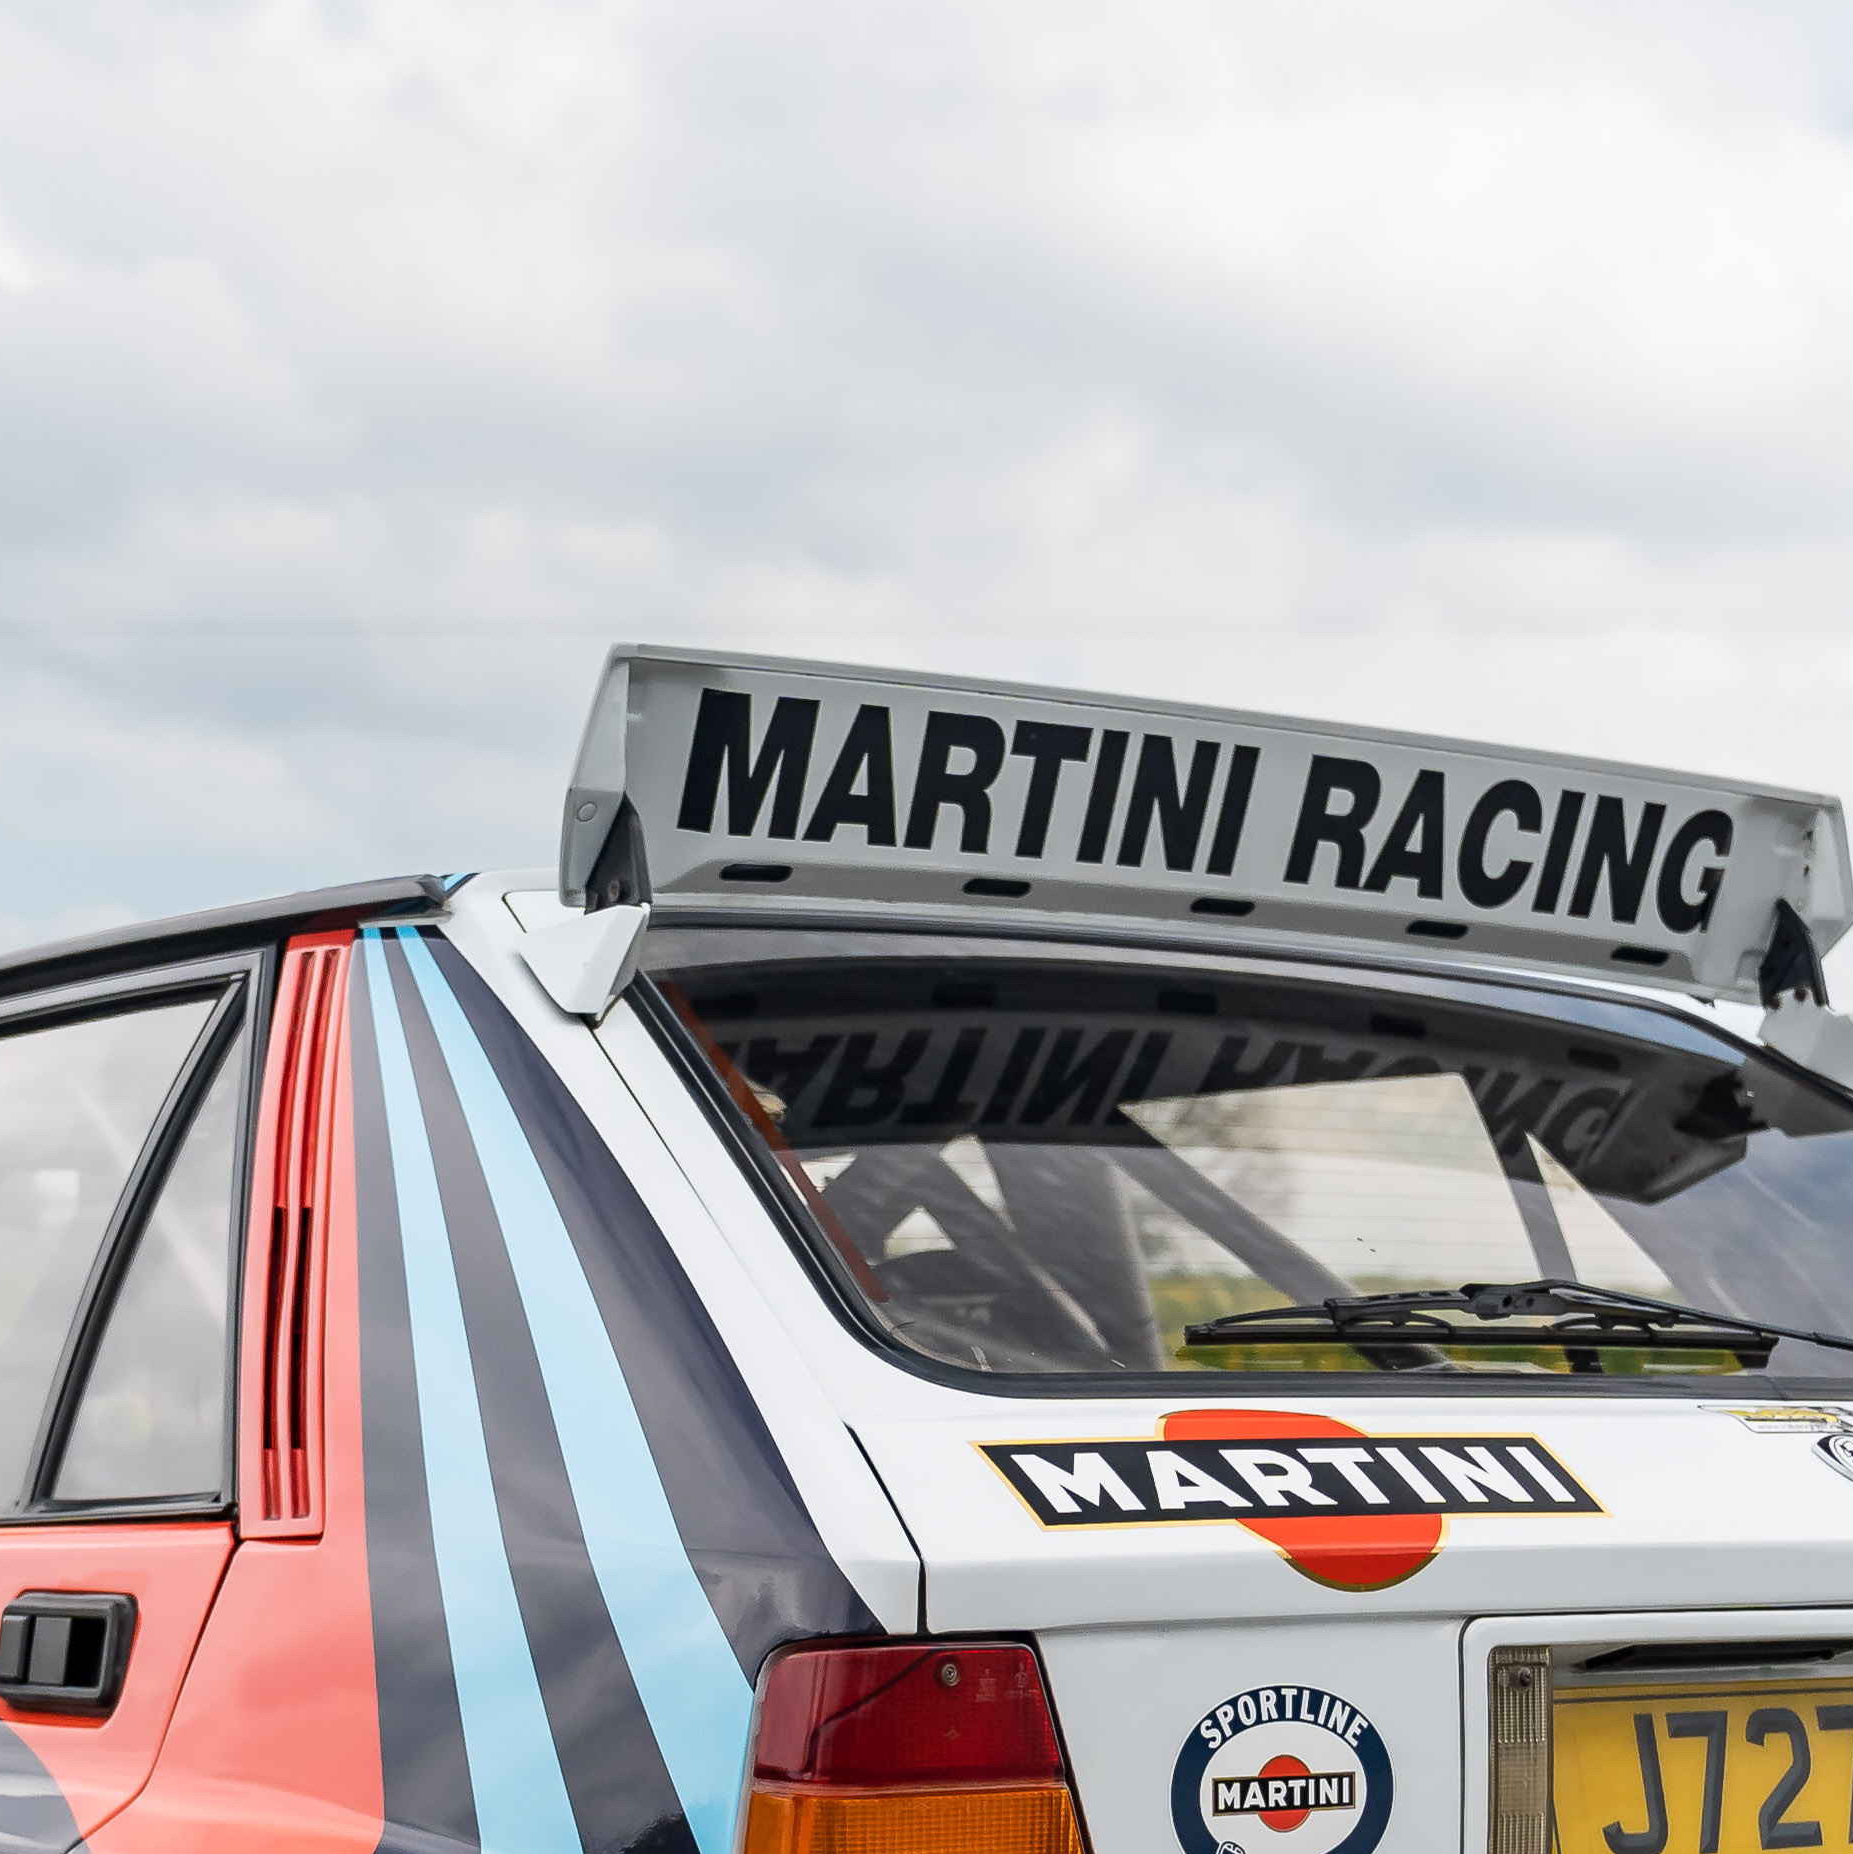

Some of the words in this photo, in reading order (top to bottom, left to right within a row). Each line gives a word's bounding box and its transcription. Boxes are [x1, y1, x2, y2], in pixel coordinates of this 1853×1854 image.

[676, 687, 1260, 876] MARTINI
[1283, 753, 1735, 937] RACING
[1010, 1446, 1577, 1514] MARTINI
[1199, 1687, 1369, 1749] SPORTLINE
[1217, 1776, 1351, 1811] MARTINI
